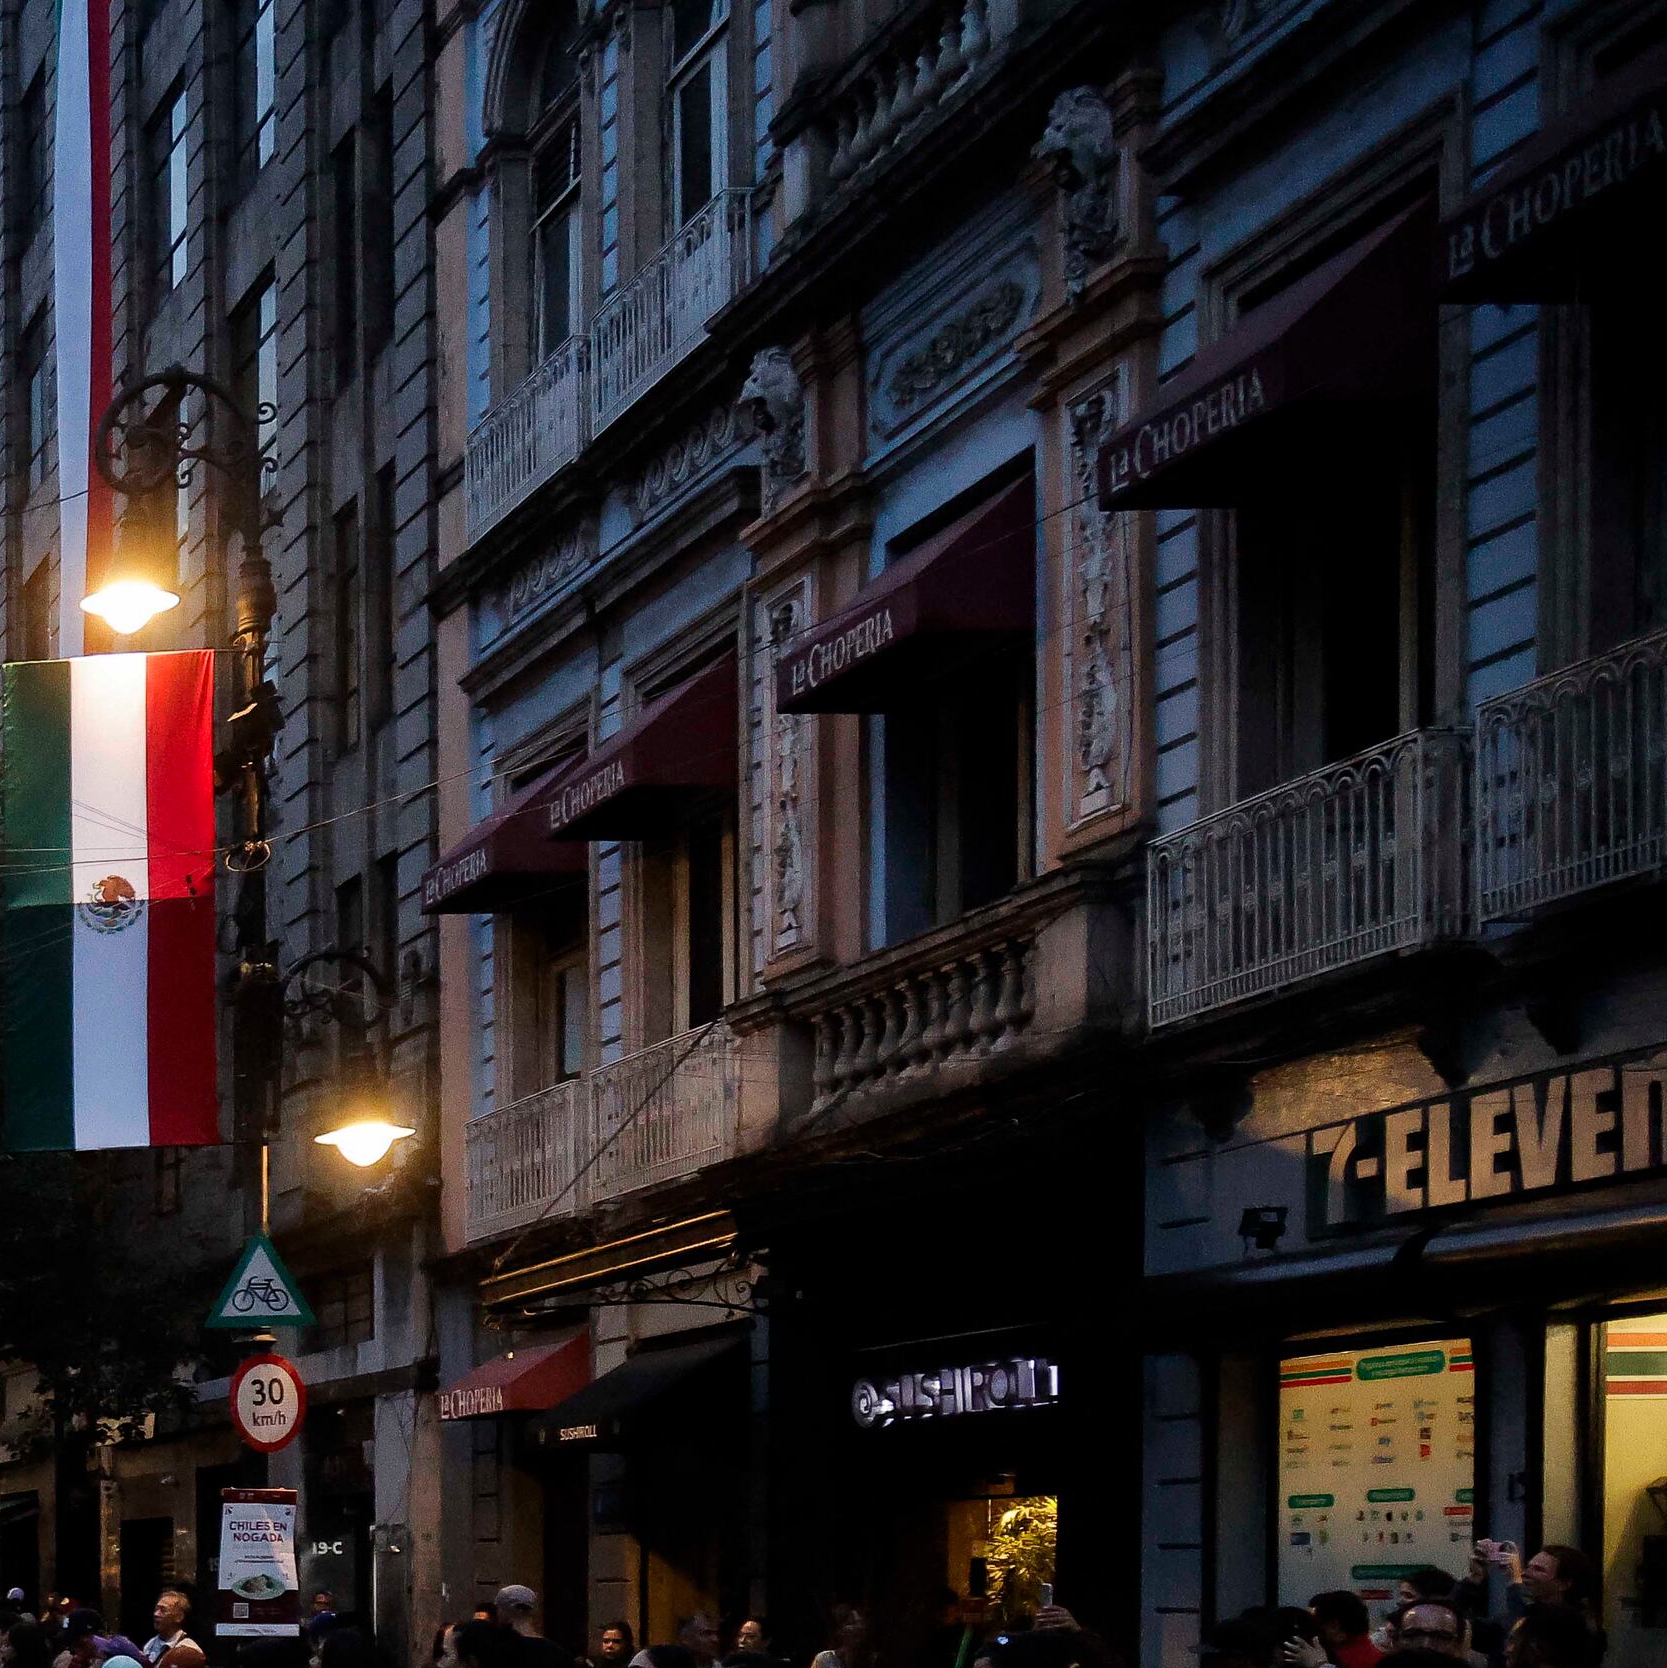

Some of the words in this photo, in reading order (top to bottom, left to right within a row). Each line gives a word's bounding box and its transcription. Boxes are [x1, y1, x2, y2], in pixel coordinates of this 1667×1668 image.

[1134, 367, 1265, 479] CHOPERIA
[808, 608, 894, 688] CHOPERIA
[251, 1378, 284, 1406] 30
[450, 1386, 504, 1420] CHOPERIA
[252, 1410, 286, 1427] km/h
[229, 1521, 270, 1531] CHILES
[273, 1522, 288, 1532] EN
[233, 1532, 284, 1543] NOGADA
[312, 1541, 344, 1555] 19-C
